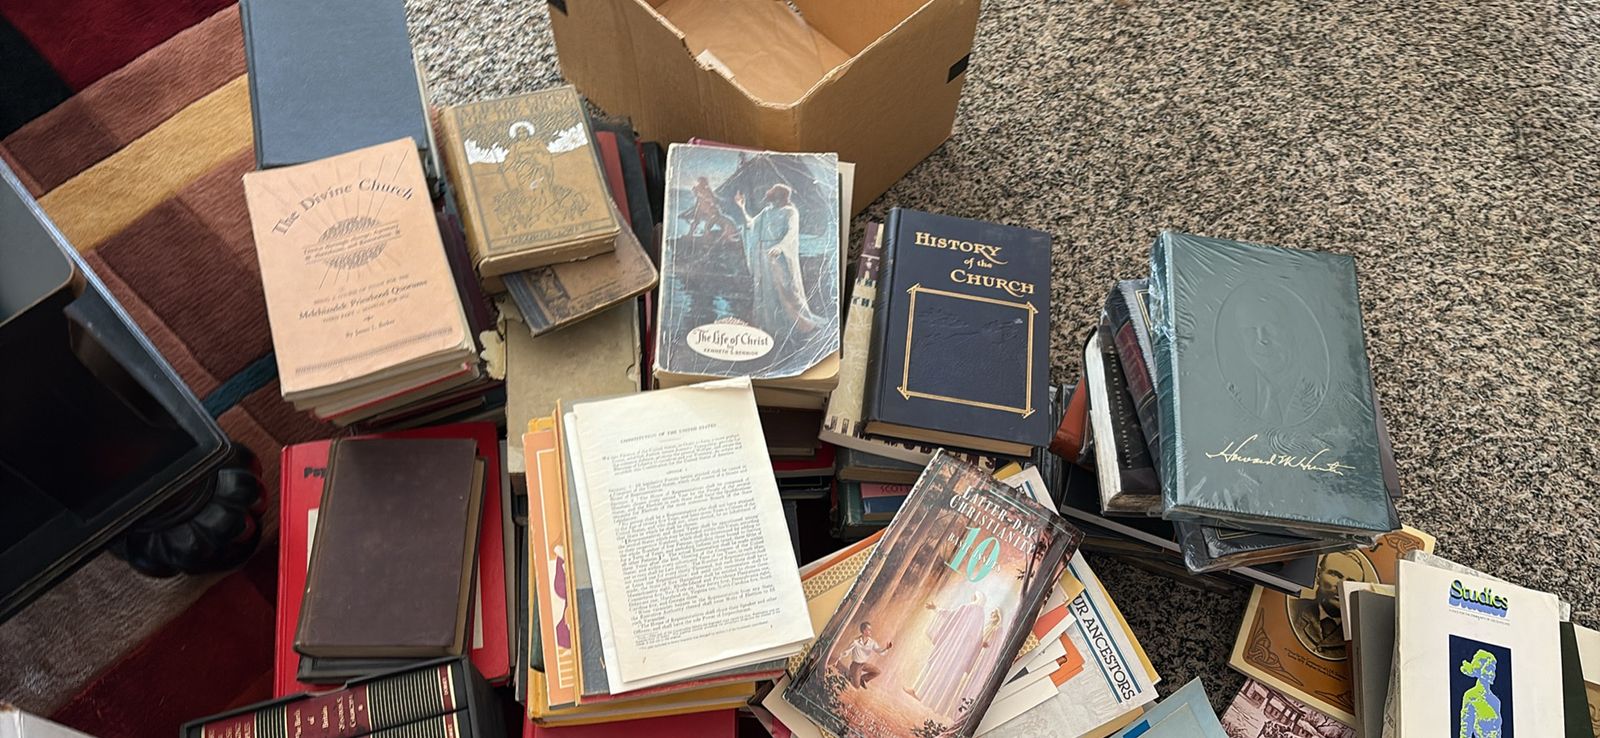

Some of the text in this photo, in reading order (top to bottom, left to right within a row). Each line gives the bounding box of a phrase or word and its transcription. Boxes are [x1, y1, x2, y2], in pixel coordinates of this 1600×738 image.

[272, 178, 413, 235] The Divine Church
[950, 269, 1035, 298] CHURCH
[964, 257, 974, 269] of
[977, 257, 993, 269] the
[693, 329, 768, 346] The Life of Christ
[949, 494, 1036, 554] CHRISTIANITY
[963, 485, 1036, 538] LATTER-DAY
[944, 526, 1000, 582] 10
[1449, 579, 1508, 613] Studies
[1082, 618, 1136, 701] ANCESTORS
